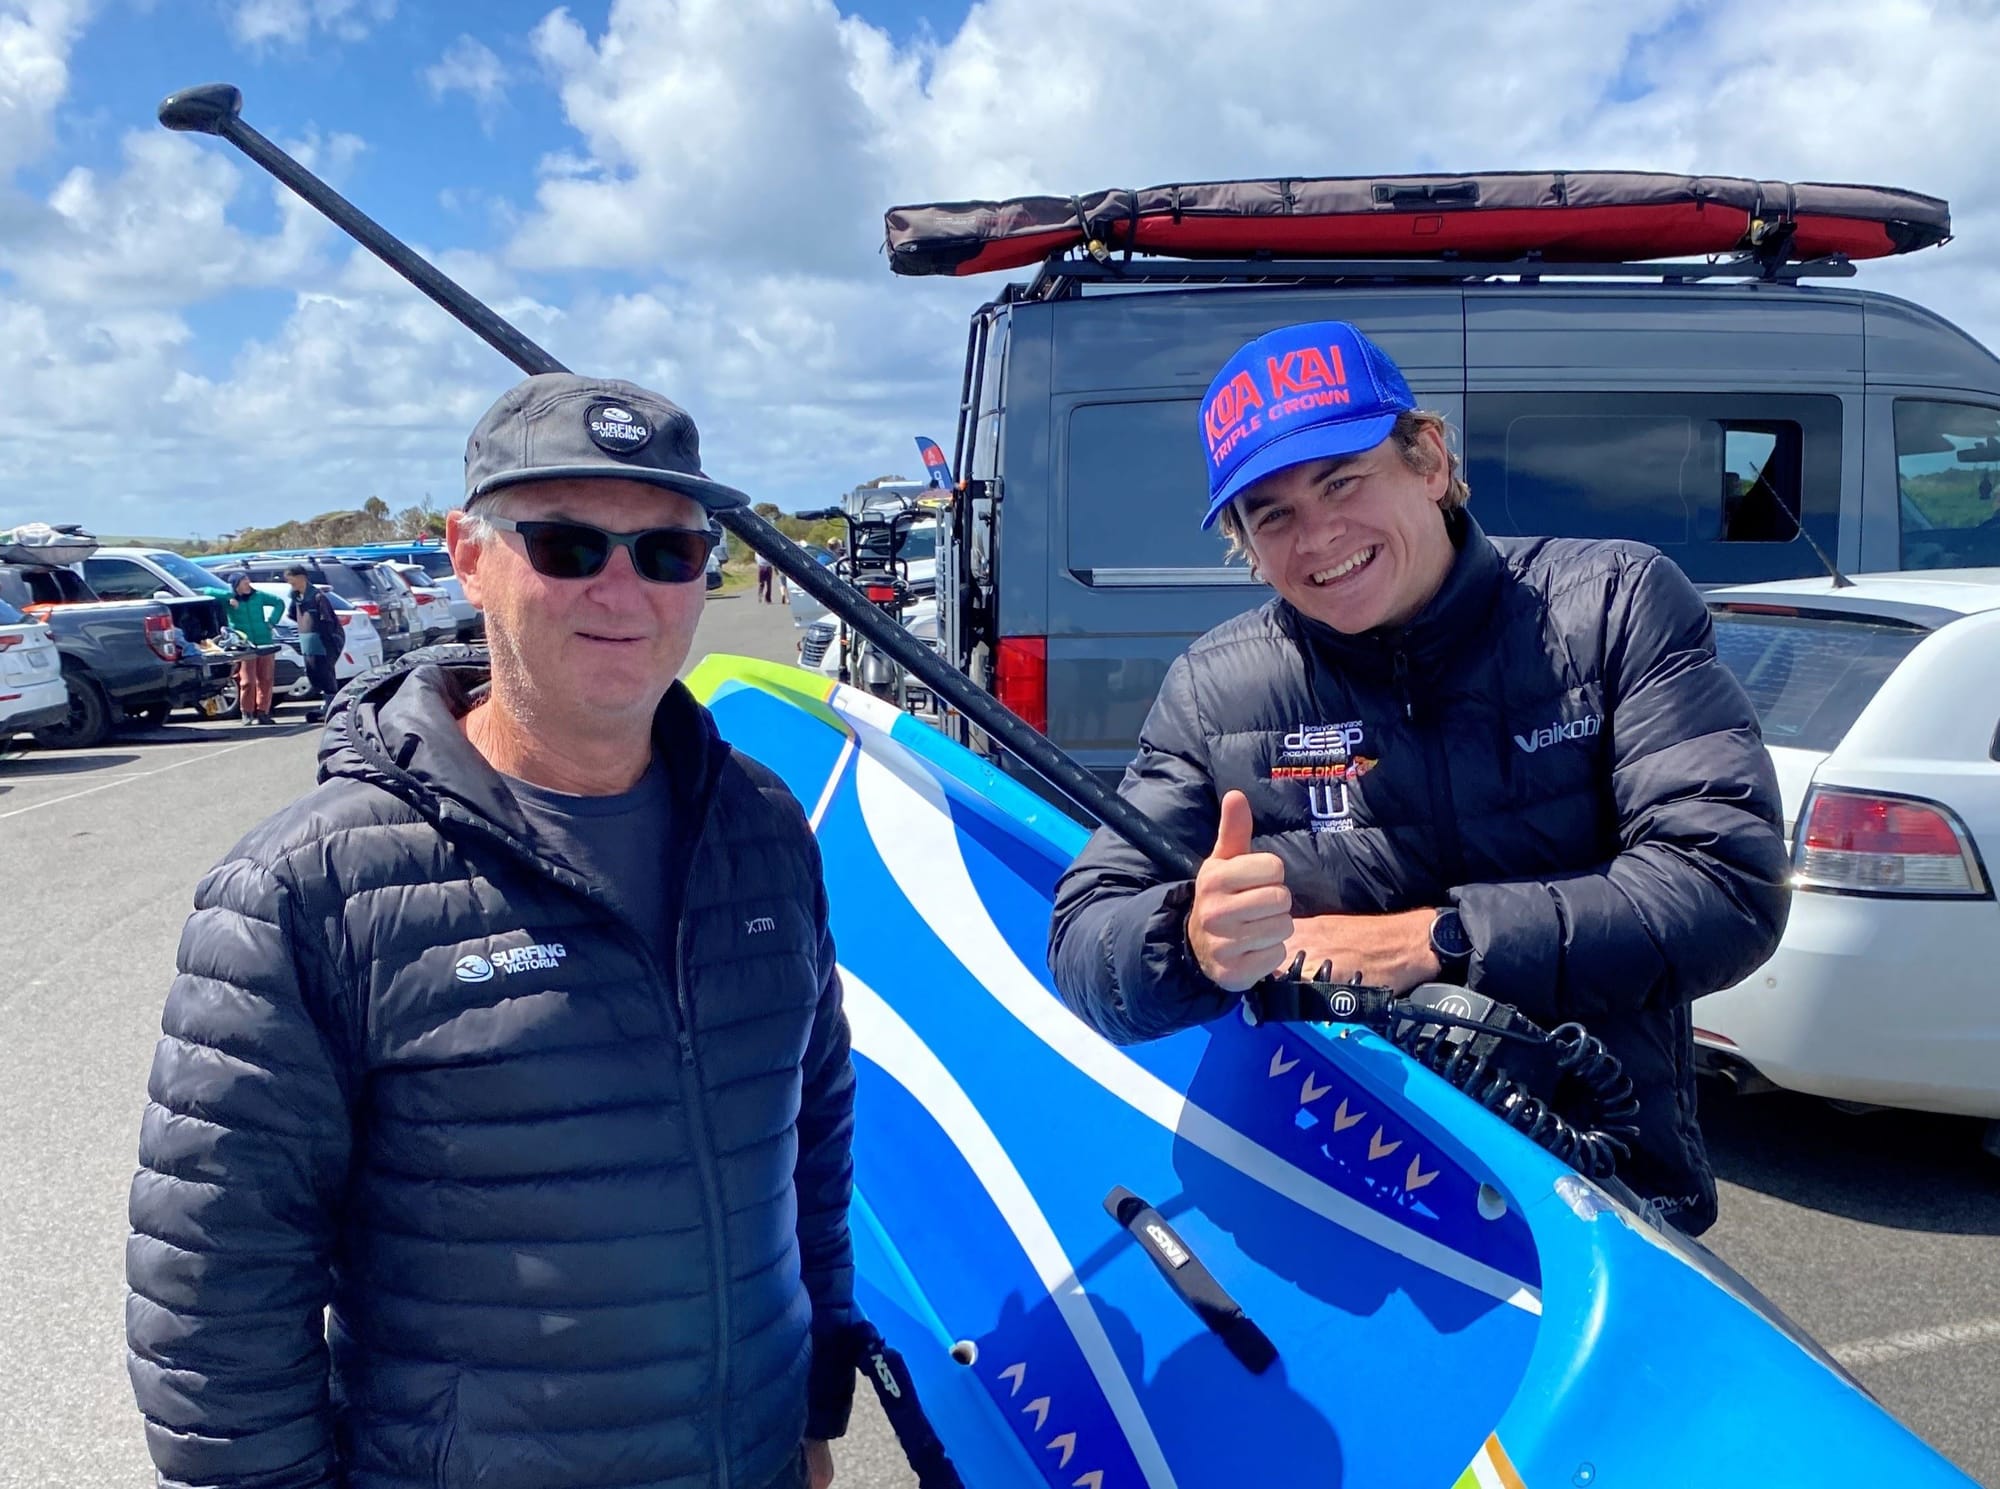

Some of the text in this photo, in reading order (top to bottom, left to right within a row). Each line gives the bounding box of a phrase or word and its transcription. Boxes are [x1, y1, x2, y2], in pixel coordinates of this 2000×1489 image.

[1205, 345, 1346, 451] KOA KAI
[591, 421, 646, 436] SURFING
[600, 430, 640, 441] VICTORIA
[1213, 389, 1350, 468] TRIPLE CROWN
[491, 943, 566, 967] SURFING
[504, 957, 559, 974] VICTORIA
